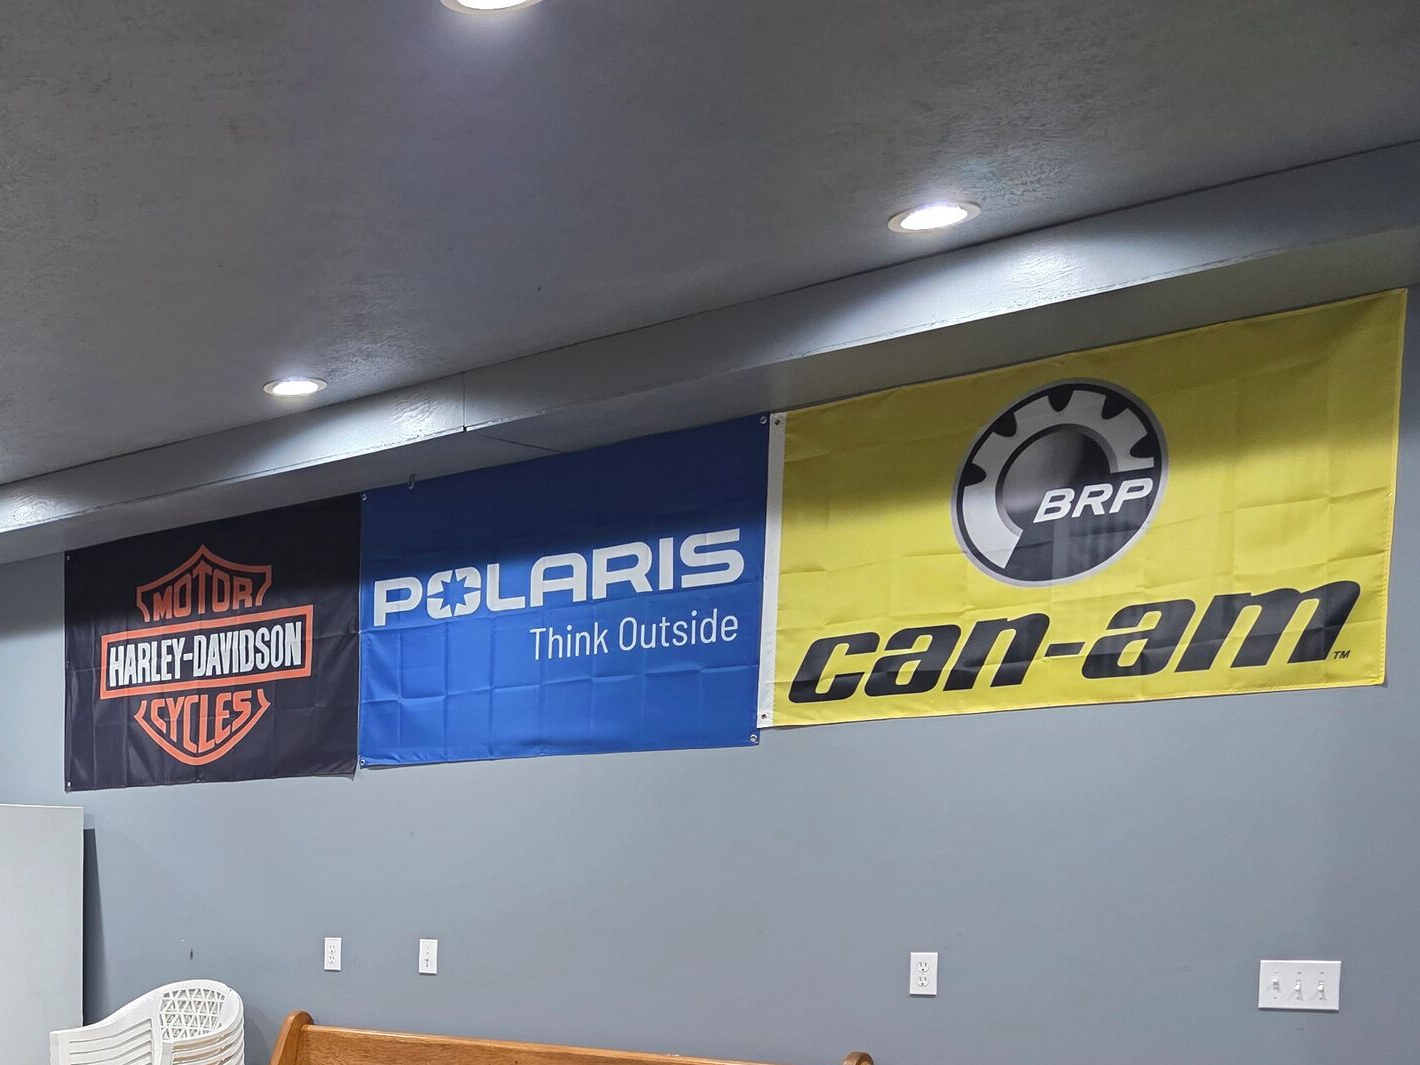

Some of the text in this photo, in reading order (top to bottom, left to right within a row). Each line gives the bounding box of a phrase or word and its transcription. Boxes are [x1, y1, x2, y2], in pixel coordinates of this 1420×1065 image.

[1033, 477, 1153, 523] BRP
[153, 559, 254, 621] MOTOR
[373, 527, 744, 626] POLARIS
[109, 621, 302, 687] HARLEY-DAVIDSON
[529, 608, 740, 661] Think Outside
[788, 580, 1362, 704] can-am
[150, 690, 252, 753] CYCLES
